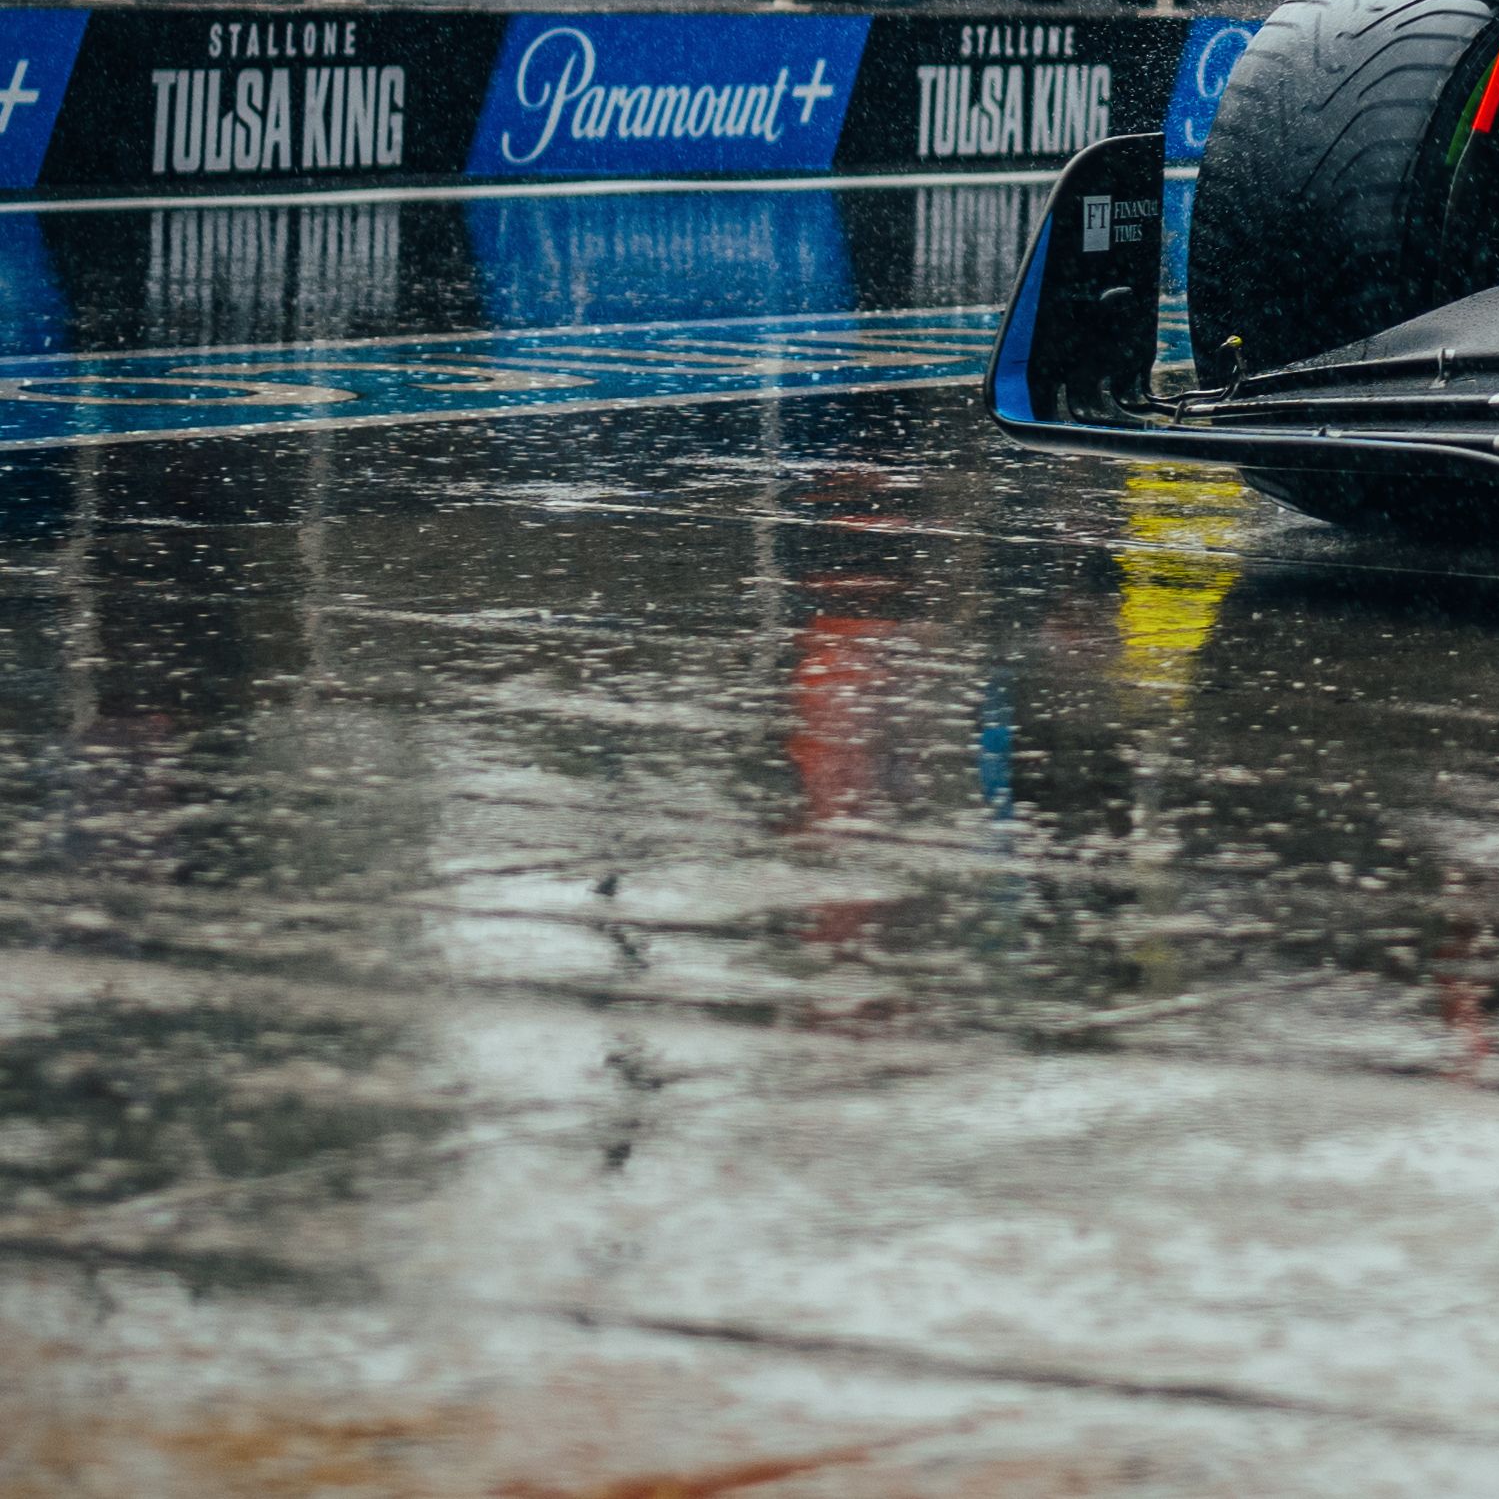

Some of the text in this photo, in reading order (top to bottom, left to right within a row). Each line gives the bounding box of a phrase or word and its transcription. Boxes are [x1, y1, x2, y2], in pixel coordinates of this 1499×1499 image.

[208, 21, 358, 58] STALLONE
[960, 25, 1076, 57] STALLONE
[502, 27, 834, 164] Paramount+
[917, 64, 1025, 157] TULSA
[1031, 64, 1111, 152] KING
[151, 64, 406, 175] TULSA KING
[1086, 202, 1110, 230] FT
[1113, 223, 1143, 243] TIMES
